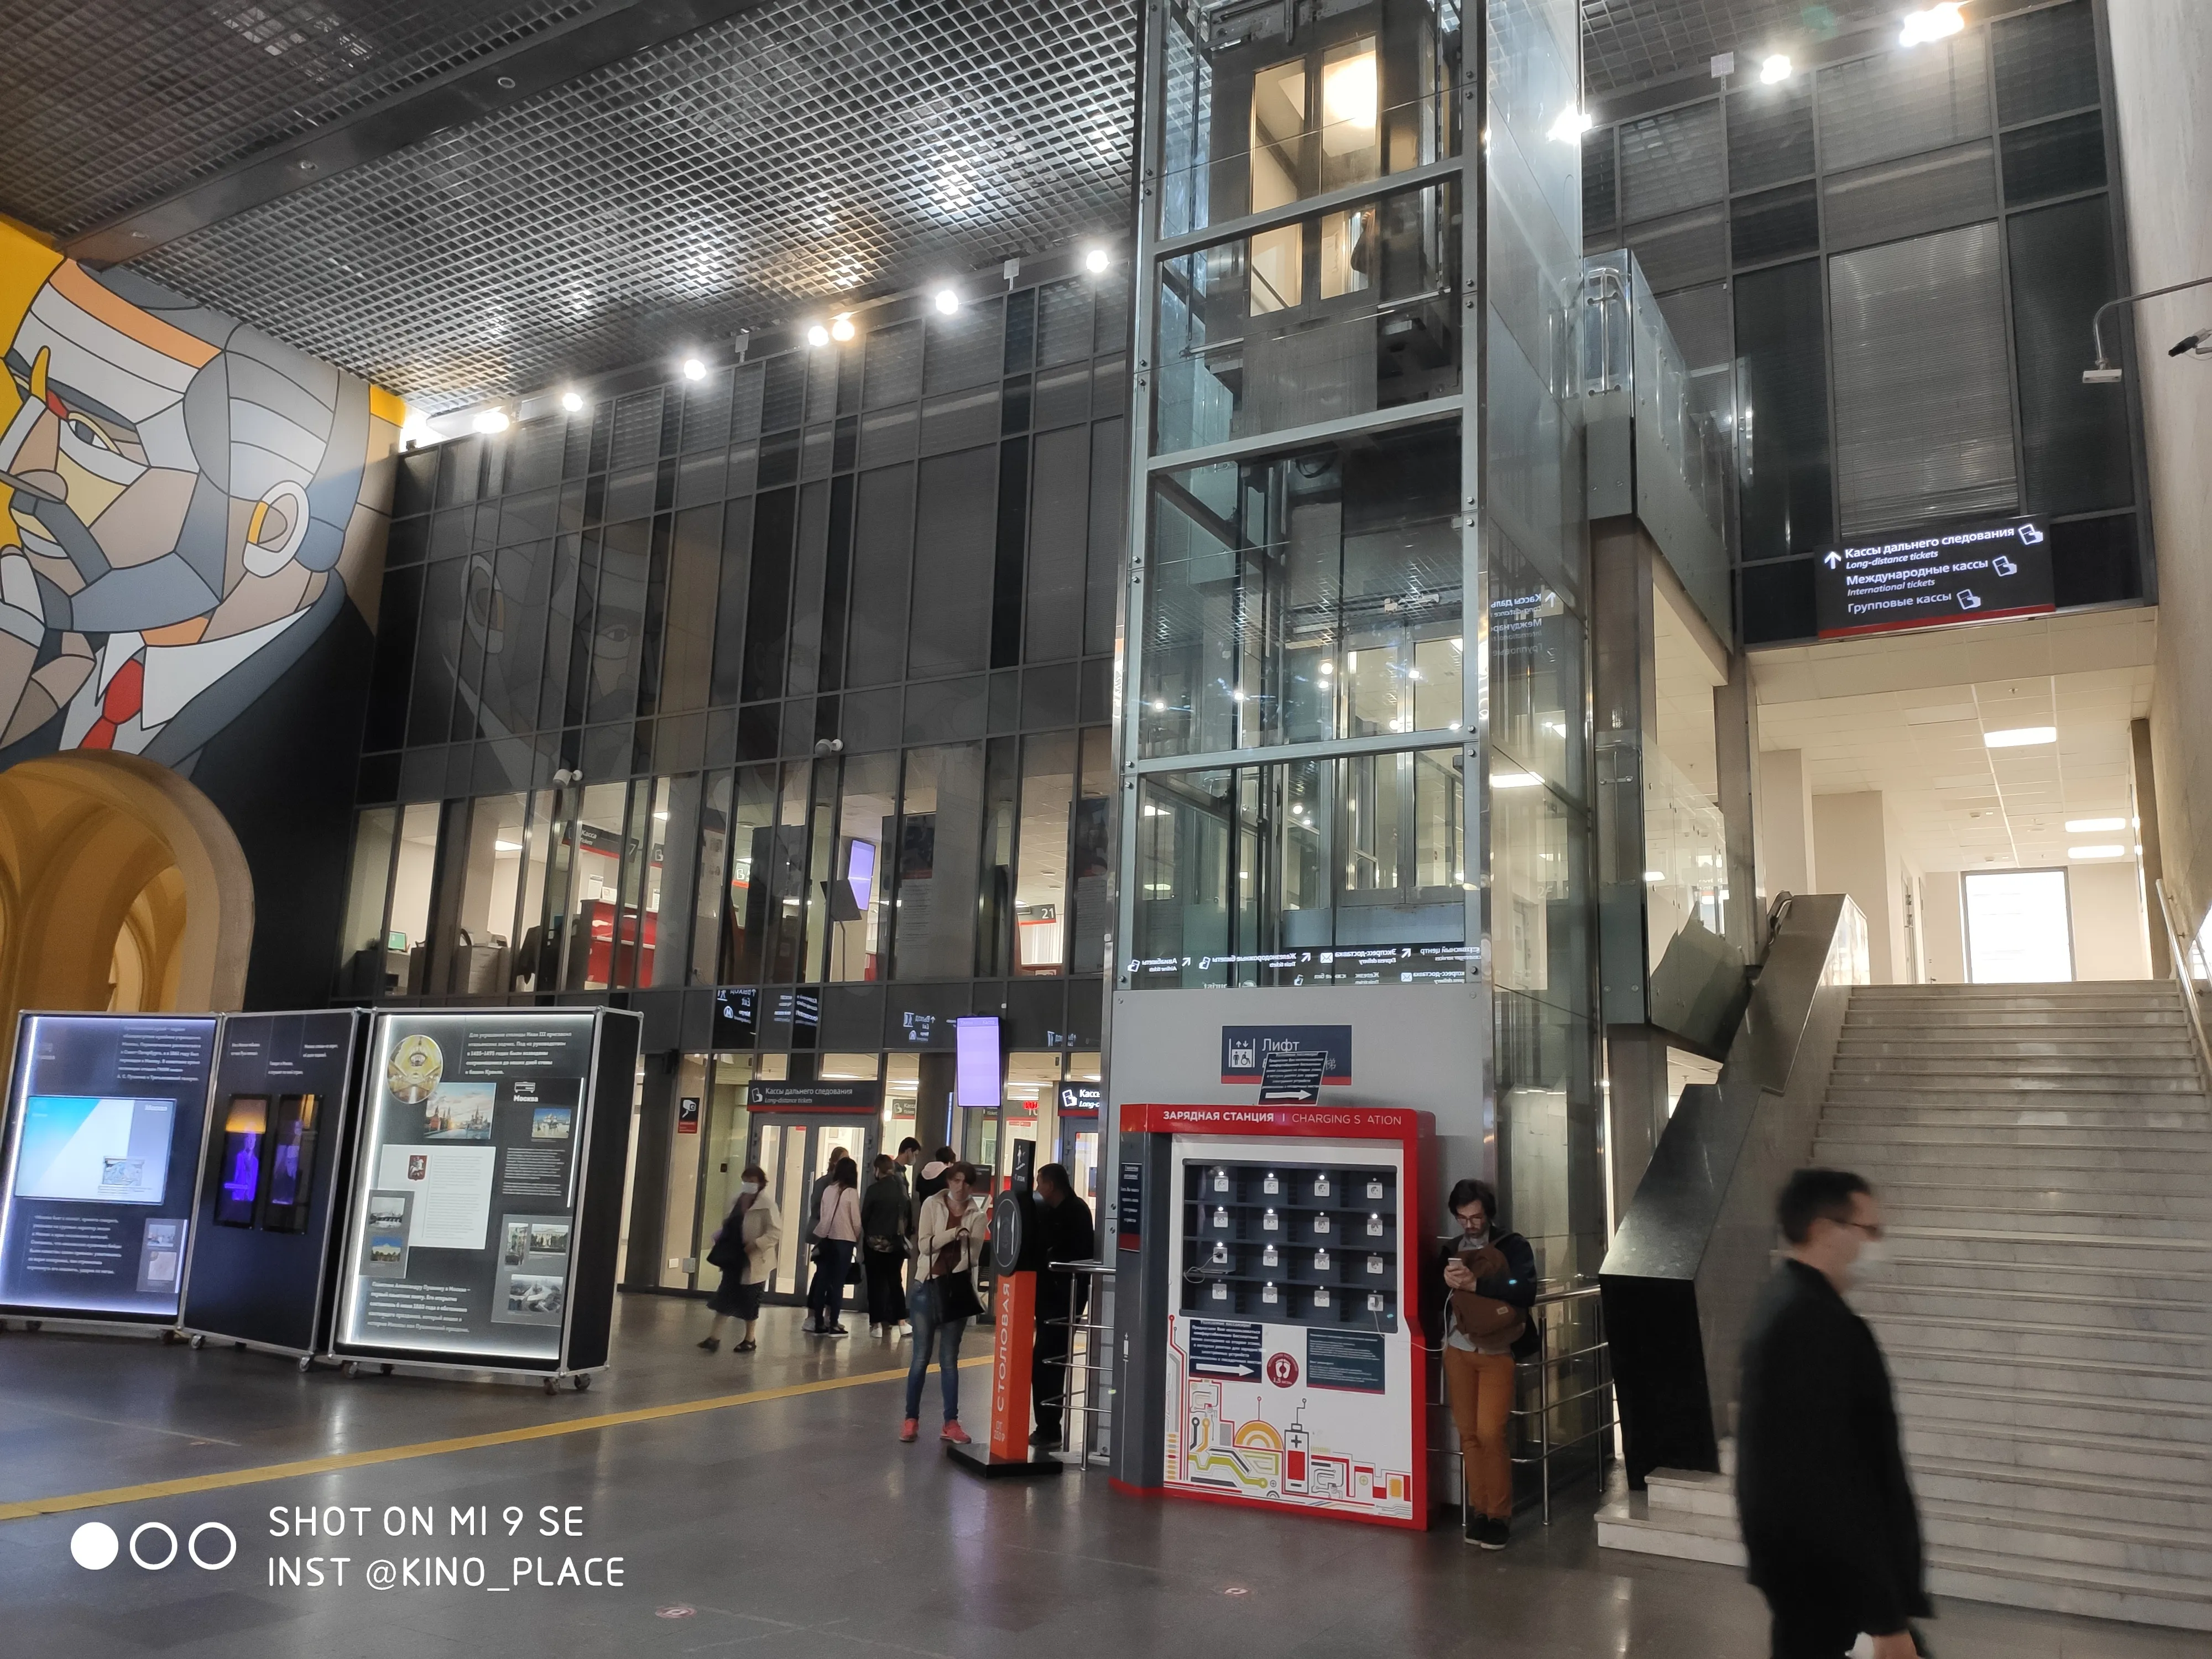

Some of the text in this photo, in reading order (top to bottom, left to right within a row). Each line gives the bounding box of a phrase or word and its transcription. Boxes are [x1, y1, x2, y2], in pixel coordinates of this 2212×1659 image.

[1845, 528, 2014, 559] Кассы дальнего следования
[1846, 550, 1938, 570] Long-distance tickets
[1846, 560, 1989, 586] Международные кассы
[1847, 578, 1935, 597] International tickets
[1848, 593, 1952, 615] Групповые кассы
[1041, 907, 1054, 919] 21
[1262, 1039, 1300, 1052] Лифт
[1163, 1110, 1275, 1124] ЗАРЯДНАЯ СТАНЦИЯ
[1292, 1113, 1402, 1126] CHARGING SATION
[997, 1283, 1010, 1411] СТОЛОВАЯ
